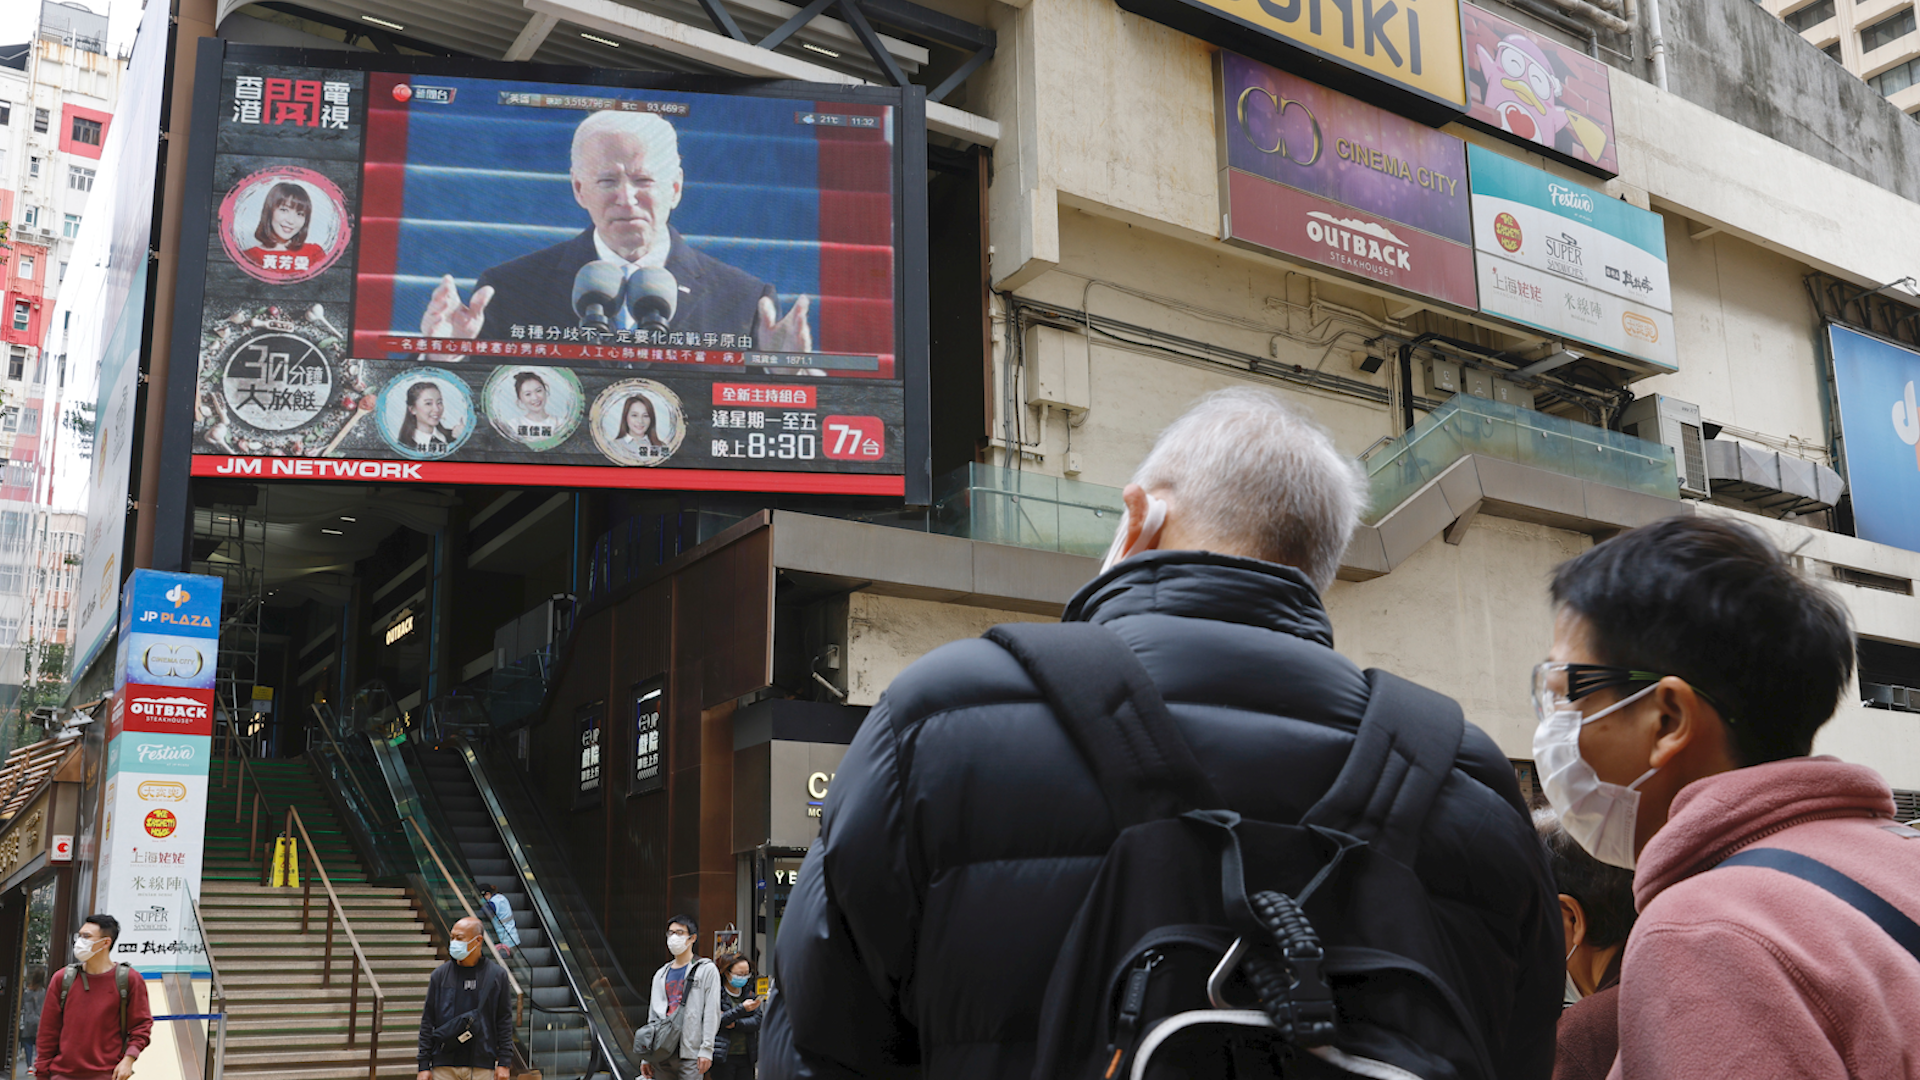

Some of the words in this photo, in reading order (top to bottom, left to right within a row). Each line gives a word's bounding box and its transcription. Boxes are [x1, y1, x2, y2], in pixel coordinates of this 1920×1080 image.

[851, 117, 875, 126] 11:32
[1335, 138, 1413, 184] CINEMA
[1416, 166, 1458, 197] CITY
[1548, 183, 1594, 213] Festiva
[1306, 220, 1411, 271] OUTBACK
[1546, 239, 1583, 266] SUPER
[786, 355, 812, 366] 1871.1
[235, 384, 318, 412] 大放餸
[722, 387, 807, 404] 全新主持組合
[712, 410, 817, 431] 逢星期一至五
[829, 424, 880, 456] 77台
[216, 458, 262, 474] JM
[272, 459, 423, 479] NETWORK
[139, 610, 158, 622] JP
[160, 612, 212, 627] PLAZA
[385, 616, 414, 646] OUTBACK
[150, 656, 178, 665] CINEMA
[179, 657, 196, 666] CITY
[130, 702, 207, 719] OUTBACK
[136, 743, 195, 763] Festiva
[153, 809, 169, 818] THE
[130, 850, 186, 865] 上海姥姥
[130, 875, 182, 891] 米線陣
[134, 912, 168, 923] SUPER
